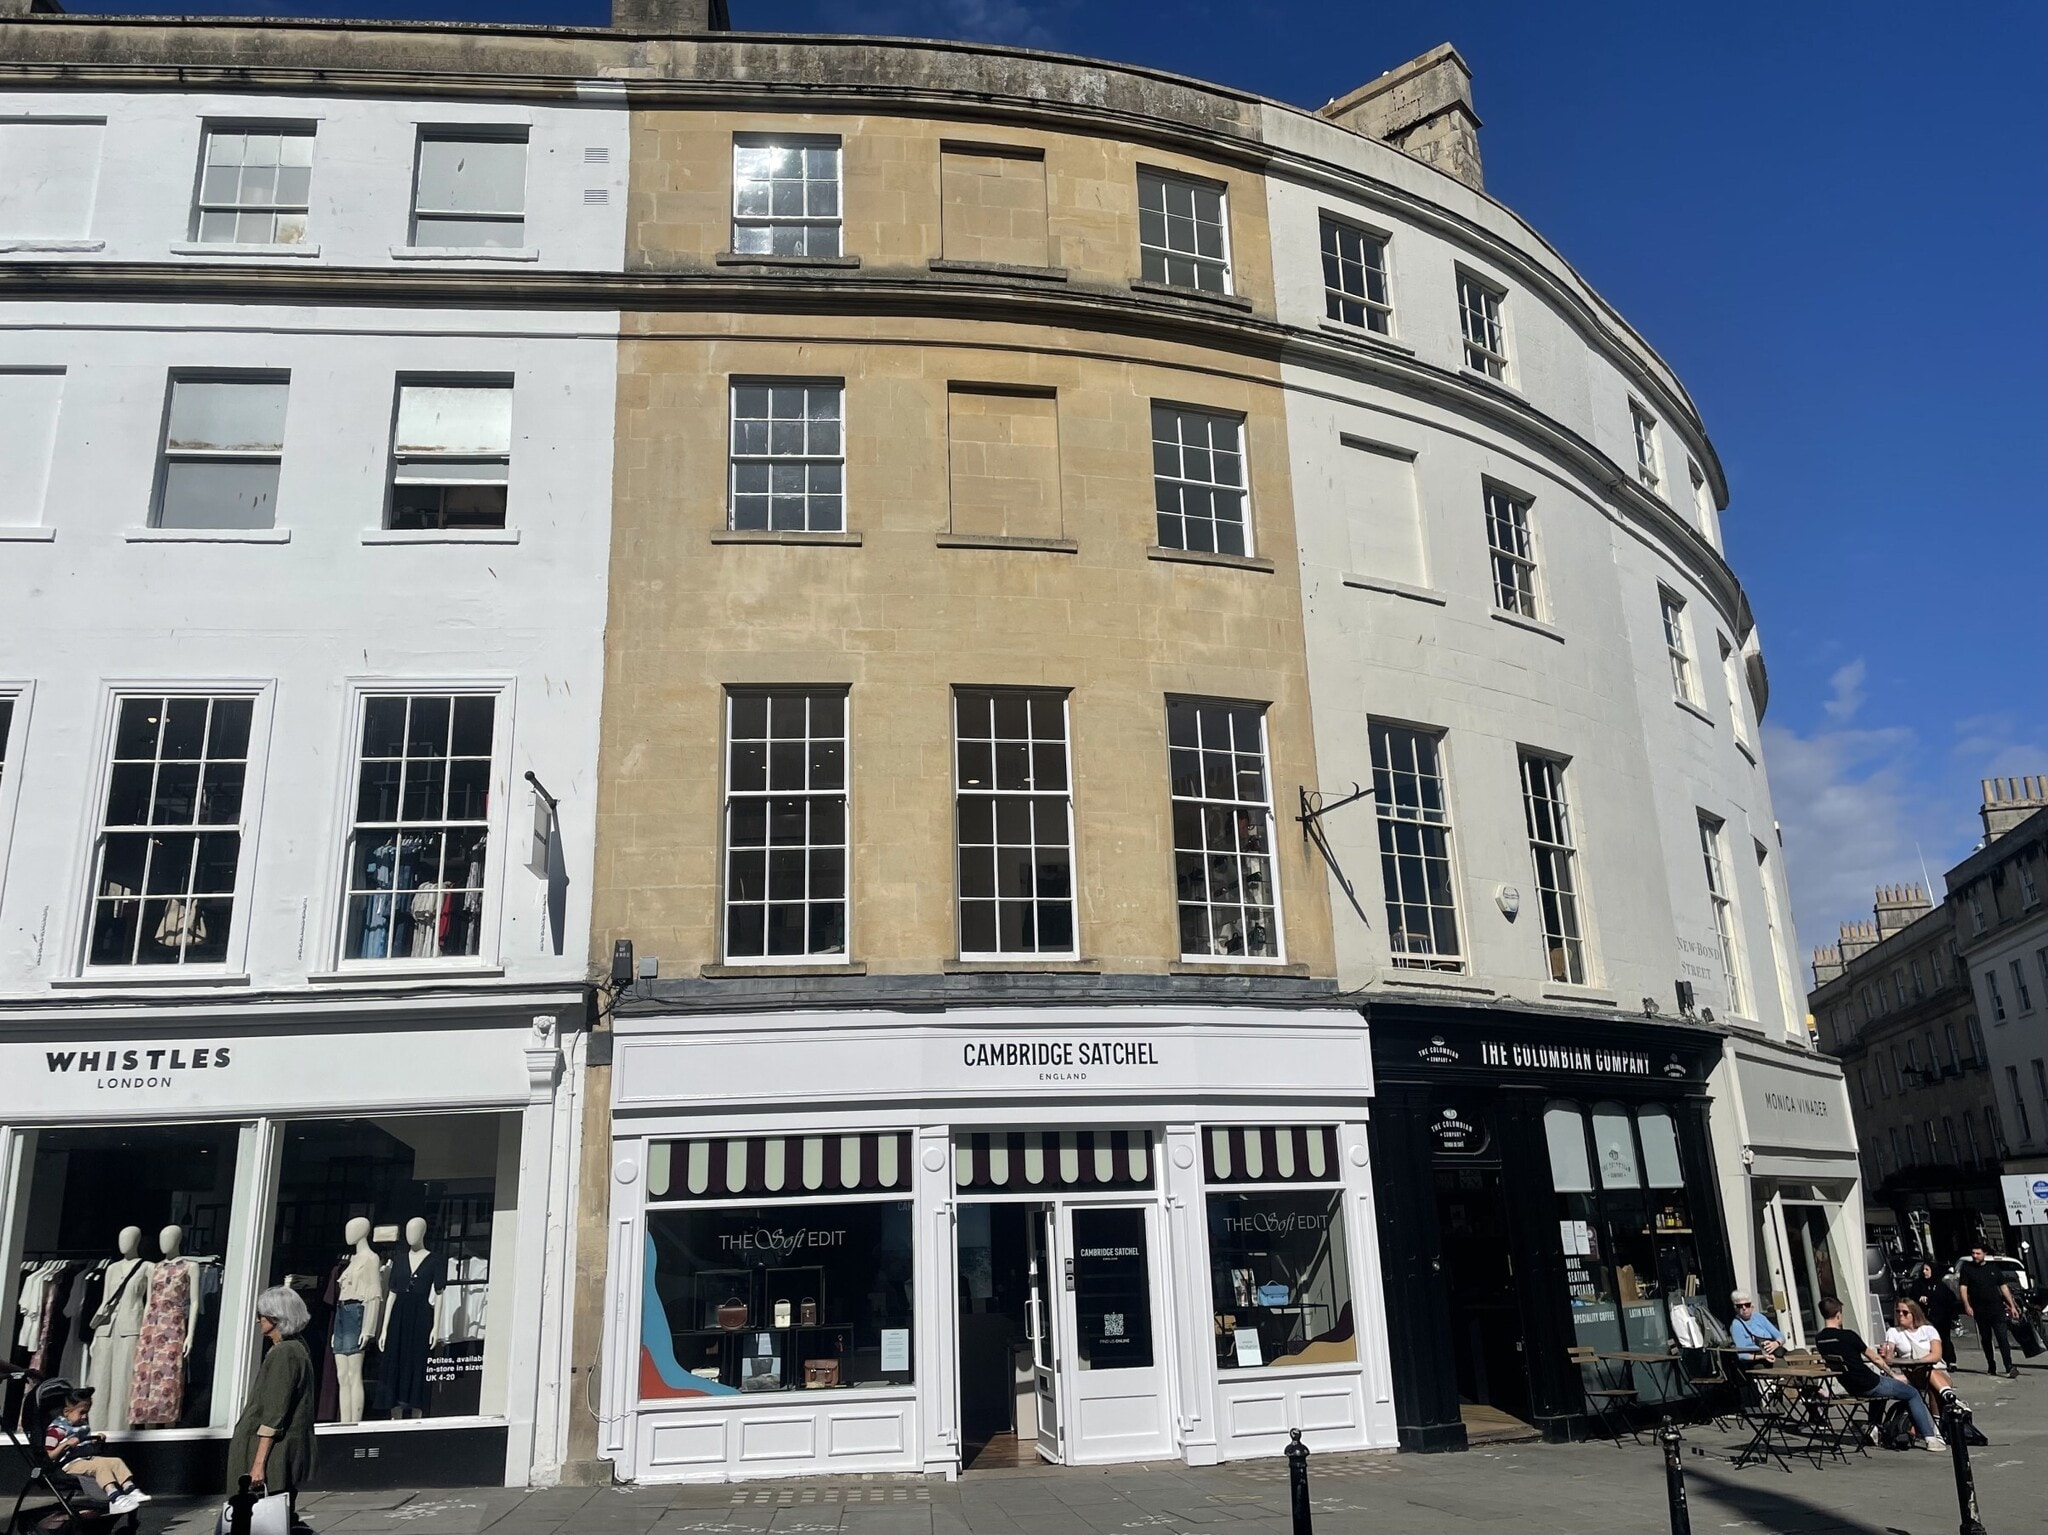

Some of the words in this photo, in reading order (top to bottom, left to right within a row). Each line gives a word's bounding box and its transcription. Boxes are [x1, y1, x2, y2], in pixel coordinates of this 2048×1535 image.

[1680, 960, 1711, 980] STREET
[964, 1043, 1073, 1066] CAMBRIDGE
[1078, 1042, 1158, 1065] SATCHEL
[1418, 1047, 1429, 1057] THE
[1430, 1046, 1459, 1059] COLOMBIAN
[1480, 1041, 1508, 1066] THE
[1513, 1043, 1592, 1071] COLOMBIAN
[1596, 1048, 1649, 1075] COMPANY
[46, 1048, 230, 1072] WHISTLES
[97, 1077, 172, 1089] LONDON
[1765, 1092, 1796, 1112] MONICA
[1797, 1098, 1828, 1117] VINADER
[1431, 1122, 1441, 1132] THE
[1442, 1120, 1472, 1132] COLOMBIAN
[1223, 1217, 1253, 1232] THE
[1253, 1212, 1295, 1238] Soft
[1297, 1215, 1328, 1229] EDIT
[718, 1234, 753, 1250] THE
[754, 1228, 806, 1256] Soft
[808, 1230, 846, 1247] EDIT
[1080, 1247, 1114, 1257] CAMBRIDGE
[1114, 1247, 1139, 1256] SATCHEL
[1565, 1258, 1581, 1270] MORE
[1567, 1270, 1590, 1283] SEATING
[1569, 1283, 1595, 1296] UPSTAIRS
[1573, 1312, 1598, 1324] SPECIALITY
[1599, 1311, 1615, 1322] COFFEE
[1628, 1307, 1641, 1318] LATIN
[427, 1357, 455, 1365] Petites,
[426, 1364, 455, 1373] in-store
[425, 1374, 437, 1382] UK
[438, 1373, 455, 1381] 4-20
